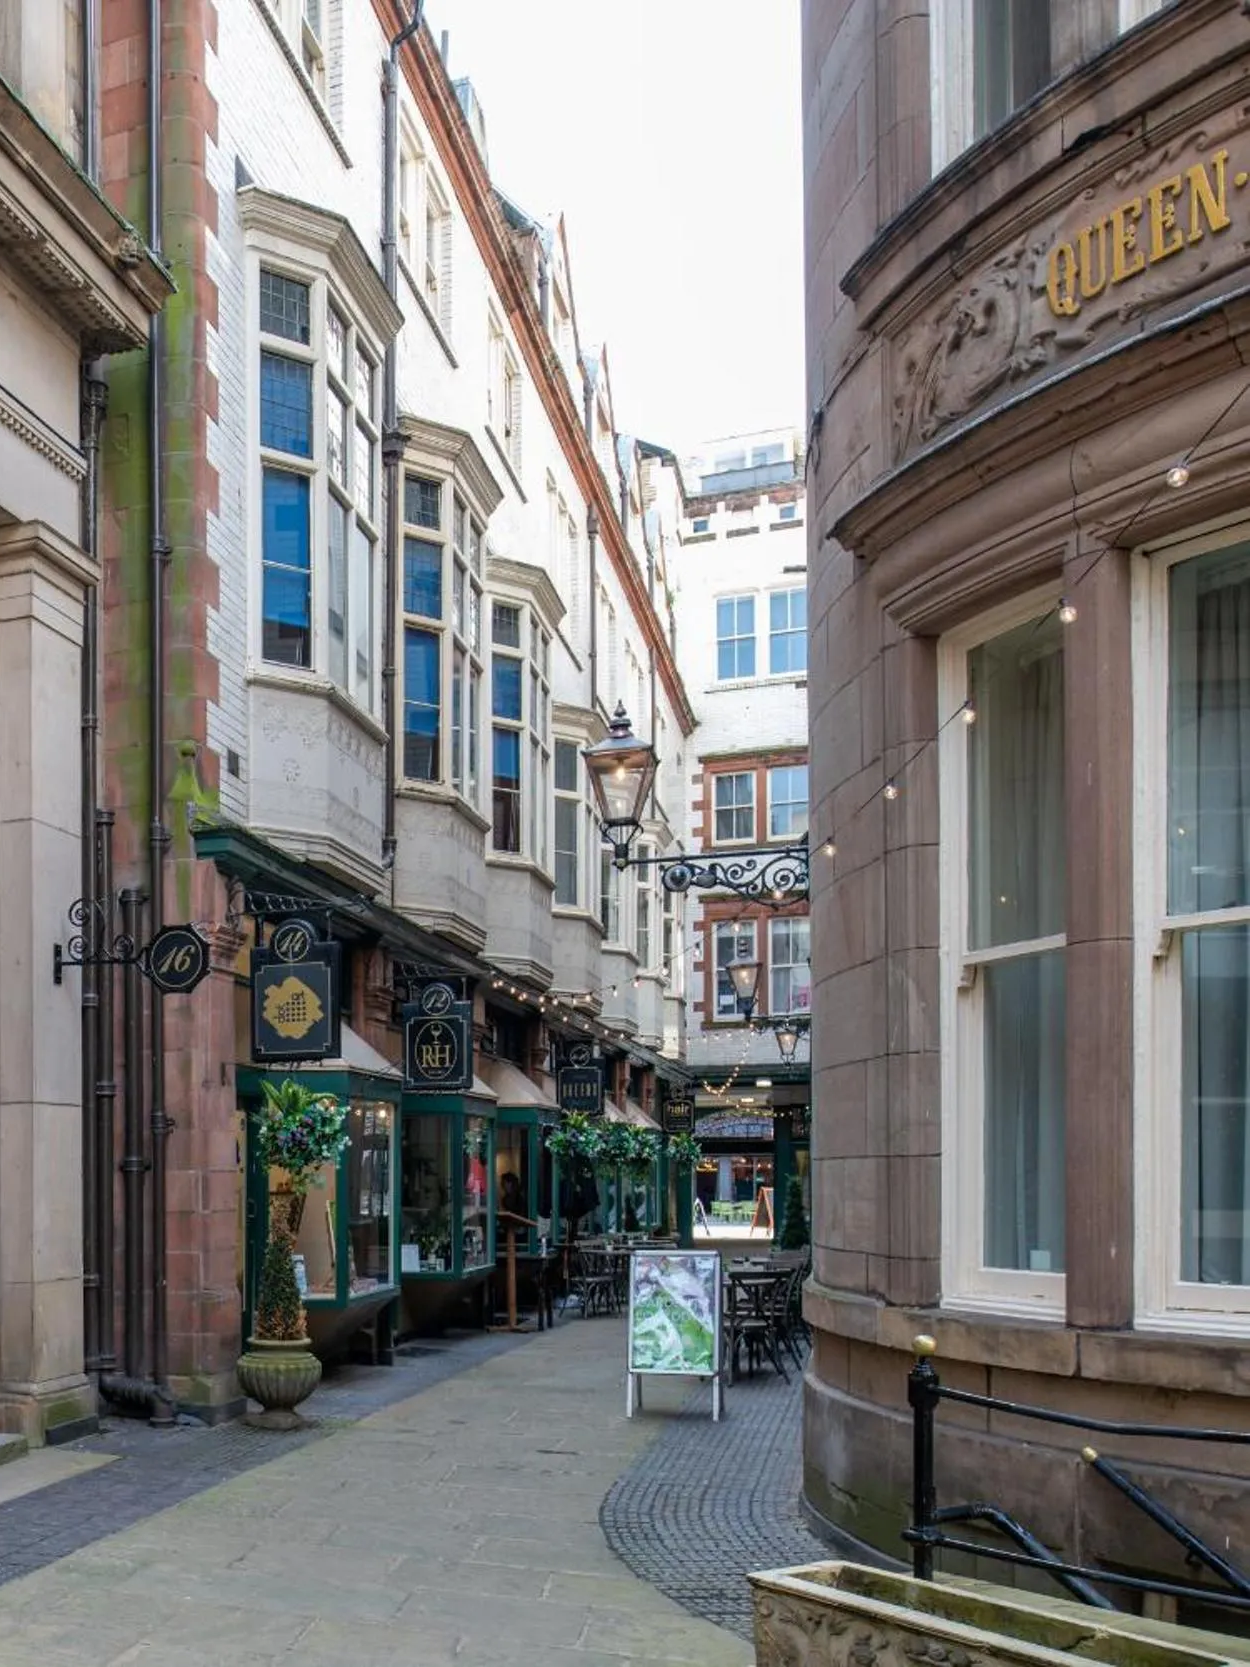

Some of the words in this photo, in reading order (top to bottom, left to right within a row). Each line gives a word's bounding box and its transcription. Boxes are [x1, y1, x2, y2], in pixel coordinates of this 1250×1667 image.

[158, 945, 195, 974] 16
[426, 992, 448, 1009] 12
[422, 1044, 450, 1068] RH
